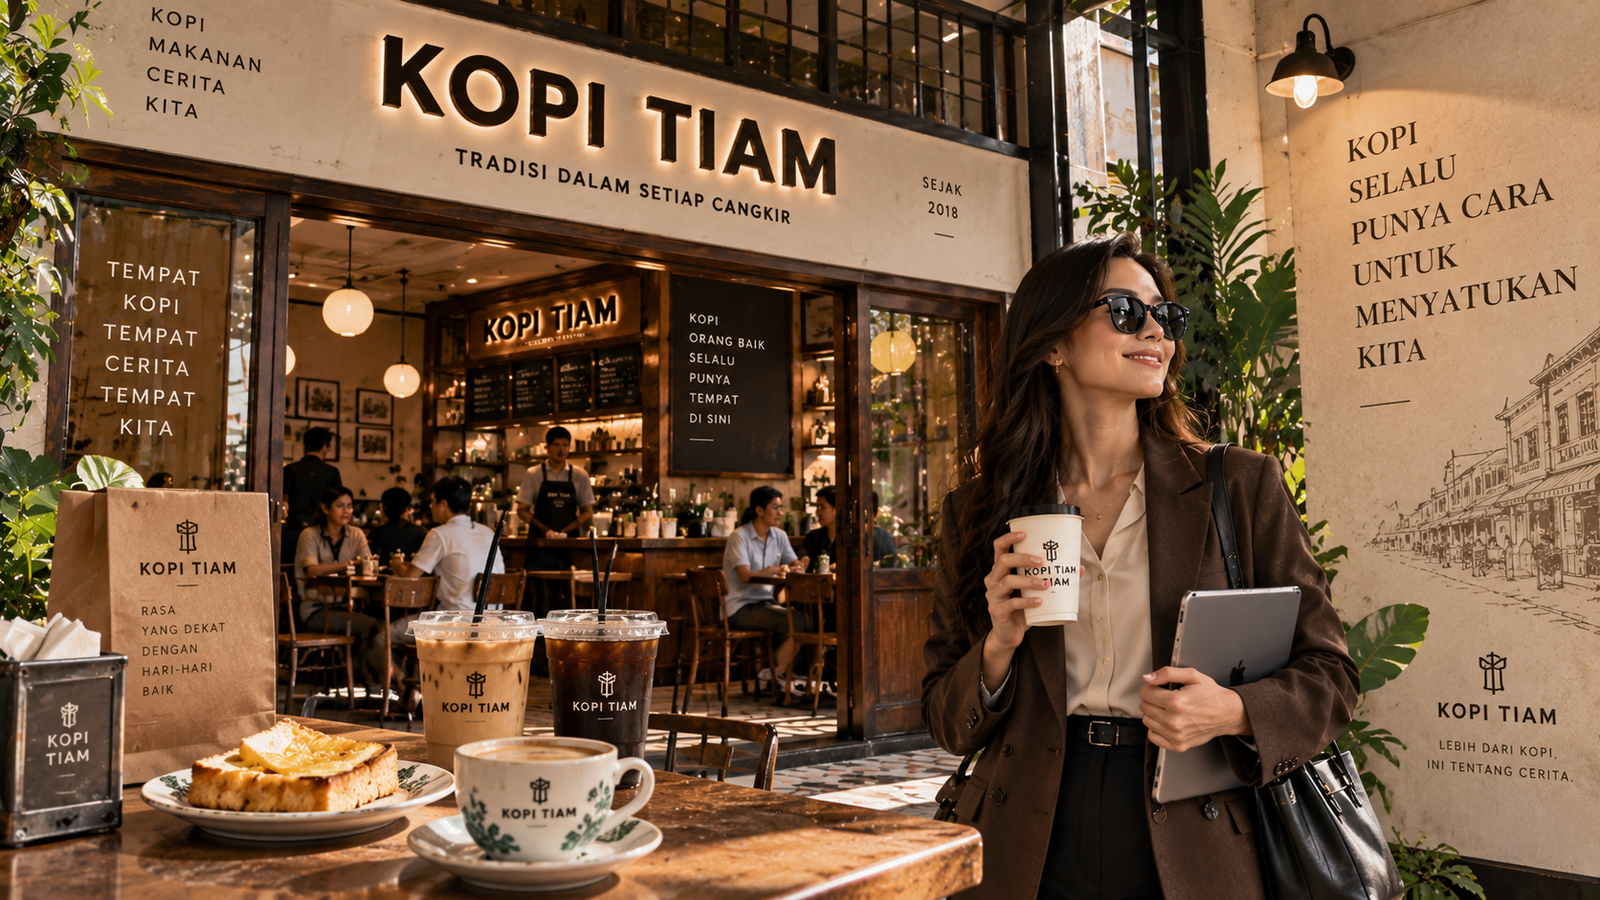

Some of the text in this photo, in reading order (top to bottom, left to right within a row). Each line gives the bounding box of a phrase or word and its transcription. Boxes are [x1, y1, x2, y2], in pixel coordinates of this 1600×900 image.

[151, 7, 205, 32] KOPI
[149, 37, 262, 73] MAKANAN
[146, 66, 226, 94] CERITA
[145, 96, 198, 119] KITA
[382, 34, 836, 196] KOPI TIAM
[1347, 121, 1417, 163] KOPI
[455, 148, 791, 225] TRADISI DALAM SETIAP CANGKIR
[923, 176, 962, 196] SEJAK
[1350, 154, 1457, 203] SELALU
[928, 201, 958, 219] 2018
[1351, 177, 1554, 245] PUNYA CARA
[106, 260, 200, 286] TEMPAT
[1353, 243, 1458, 286] UNTUK
[123, 294, 179, 316] KOPI
[1355, 266, 1578, 329] MENYATUKAN
[484, 310, 540, 343] KOPI
[551, 294, 618, 332] TIAM
[689, 312, 719, 326] KOPI
[103, 324, 198, 347] TEMPAT
[689, 333, 765, 350] ORANG BAIK
[689, 352, 736, 367] SELALU
[1357, 338, 1427, 369] KITA
[105, 355, 189, 377] CERITA
[689, 372, 731, 386] PUNYA
[101, 386, 195, 407] TEMPAT
[689, 392, 739, 406] TEMPAT
[120, 418, 173, 437] KITA
[689, 412, 731, 425] DI SINI
[140, 560, 236, 576] KOPI TIAM
[1024, 566, 1050, 576] KOPI
[142, 606, 175, 616] RASA
[142, 623, 225, 636] YANG DEKAT
[142, 644, 197, 656] DENGAN
[143, 662, 212, 676] HARI-HARI
[143, 685, 173, 696] BAIK
[442, 702, 509, 713] KOPI TIAM
[573, 701, 636, 711] KOPI TIAM
[1437, 702, 1557, 725] KOPI TIAM
[48, 731, 88, 748] KOPI
[1439, 740, 1476, 753] LEBIH
[1482, 742, 1514, 755] DARI
[46, 749, 89, 766] TIAM
[1427, 759, 1574, 782] INI TENTANG CERITA.
[502, 807, 576, 819] KOPI TIAM
